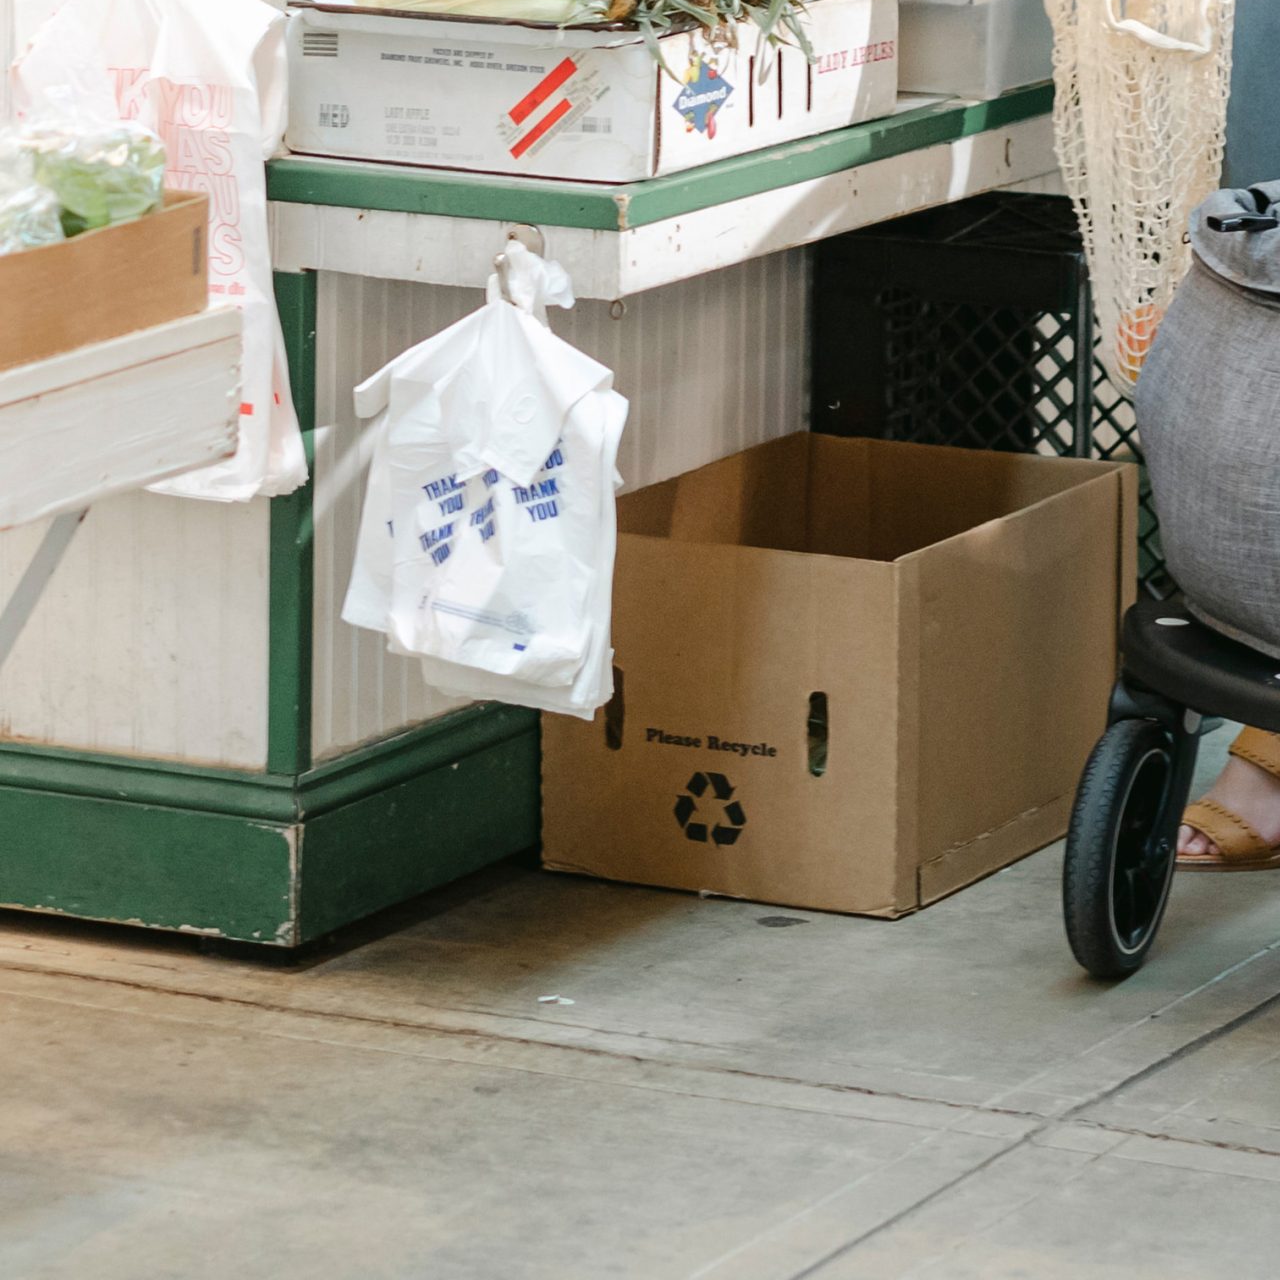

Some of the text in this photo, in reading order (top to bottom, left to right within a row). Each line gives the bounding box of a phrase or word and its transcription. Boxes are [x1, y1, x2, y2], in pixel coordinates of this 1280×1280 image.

[817, 40, 894, 74] LADY APPLES
[679, 86, 727, 110] Diamond
[512, 478, 560, 505] THANK
[438, 493, 464, 517] YOU
[526, 500, 558, 522] YOU
[646, 727, 778, 757] Please Recycle
